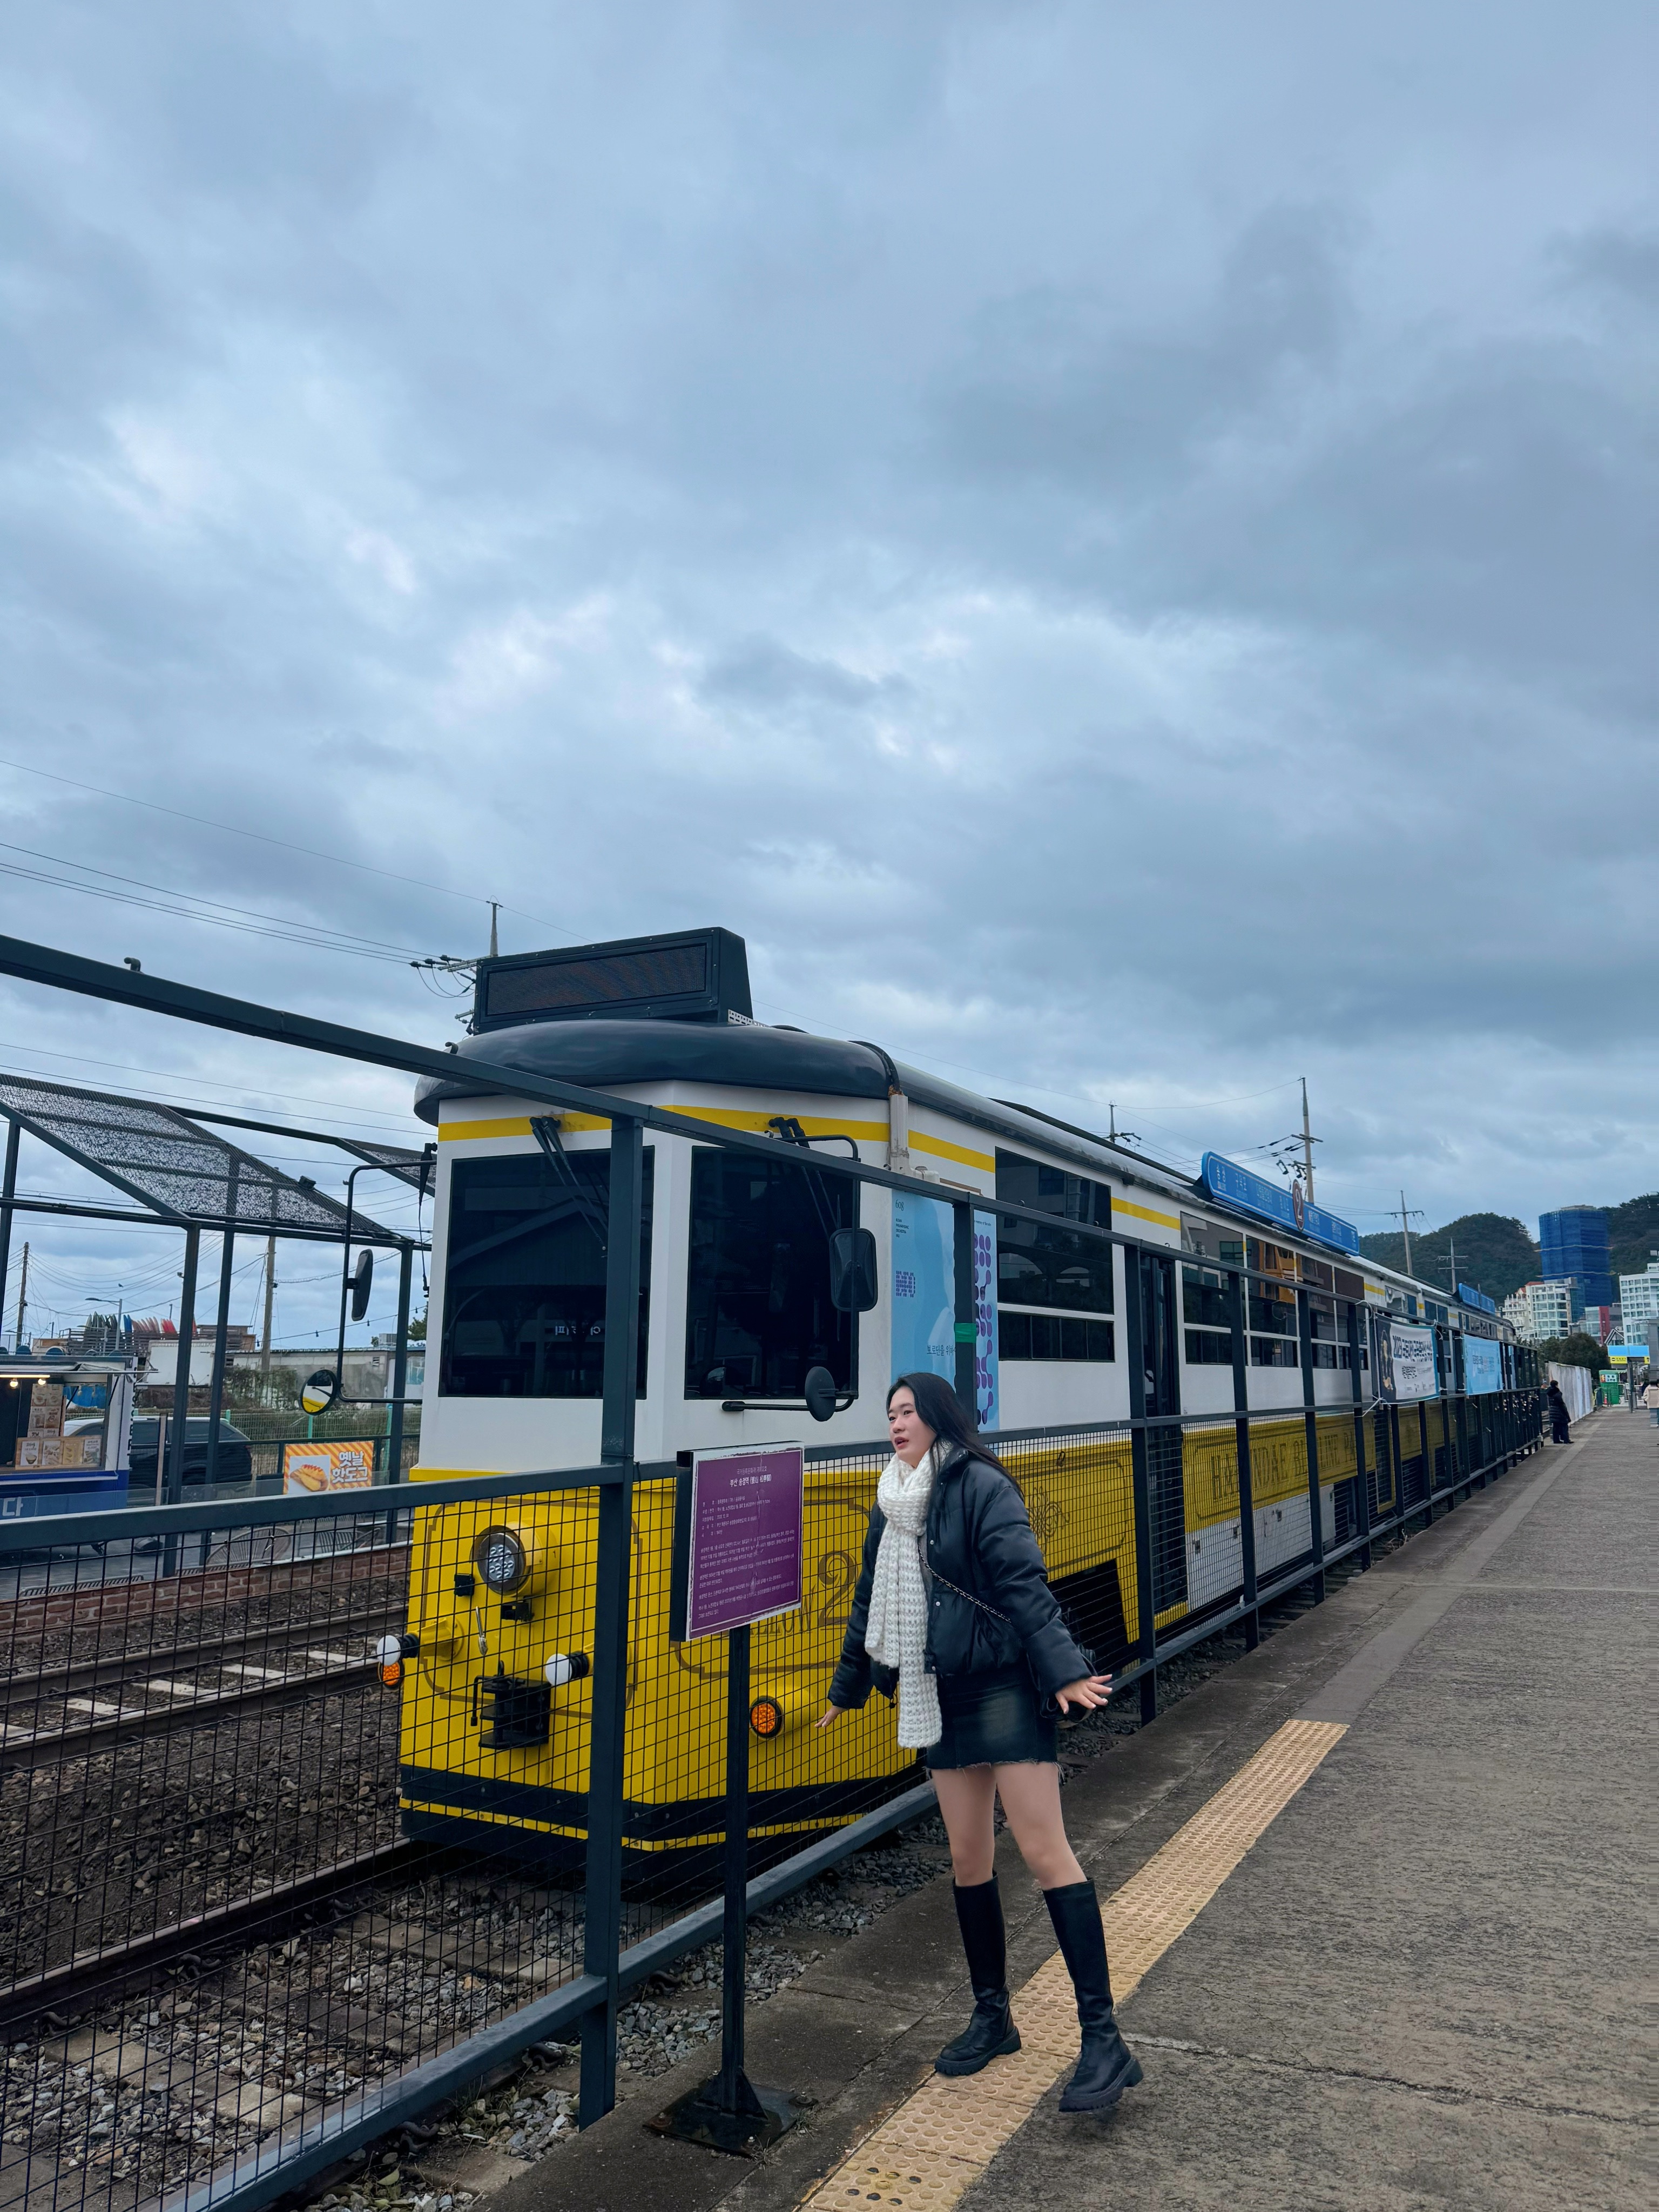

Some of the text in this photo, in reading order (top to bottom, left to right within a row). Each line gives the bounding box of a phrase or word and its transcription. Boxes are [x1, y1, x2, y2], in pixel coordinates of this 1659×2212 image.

[1216, 1164, 1226, 1183] 송정
[895, 1199, 904, 1211] 608
[1295, 1188, 1303, 1222] 2
[339, 1450, 365, 1468] 옛날
[332, 1466, 368, 1484] 핫도그
[1211, 1442, 1289, 1501] HANDAE
[730, 1478, 738, 1487] 부산
[739, 1476, 750, 1486] 송정역
[818, 1550, 859, 1631] 2
